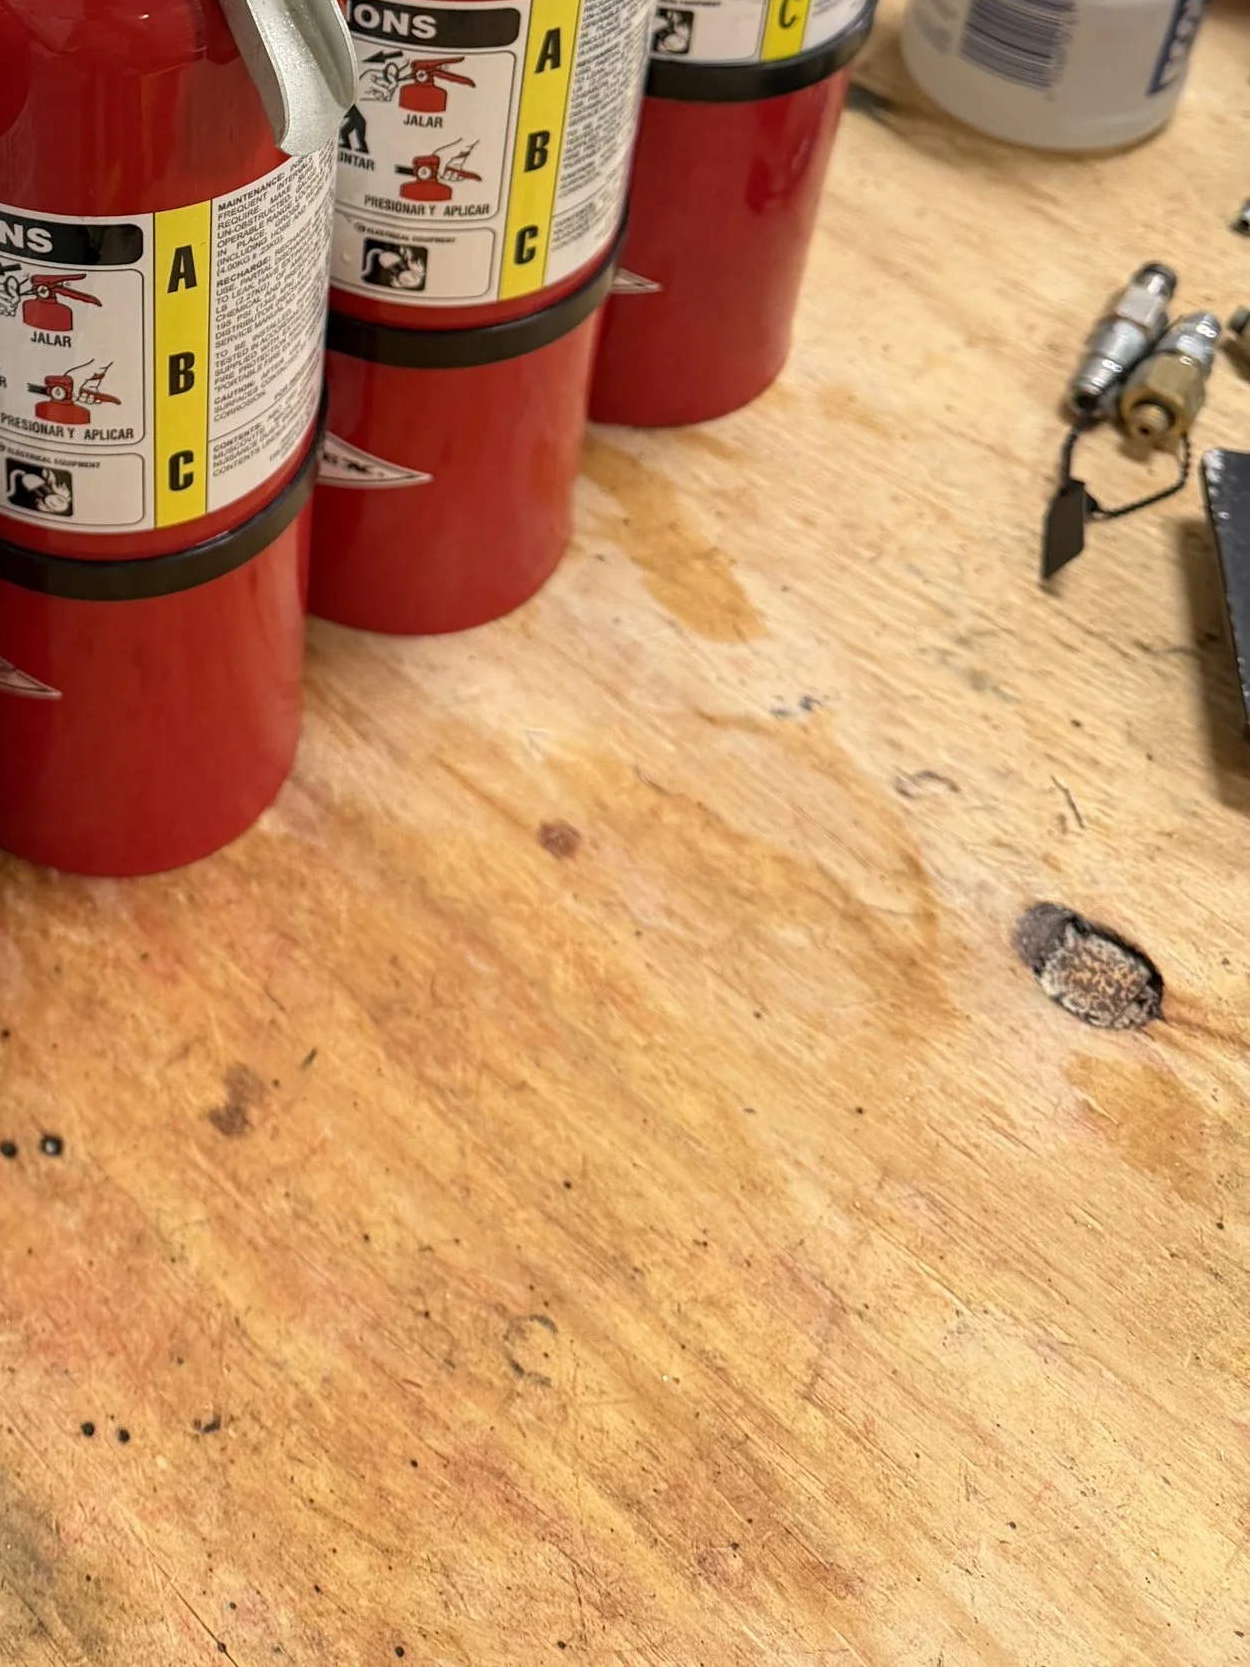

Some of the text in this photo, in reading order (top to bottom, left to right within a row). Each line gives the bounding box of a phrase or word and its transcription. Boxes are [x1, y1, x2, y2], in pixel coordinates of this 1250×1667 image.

[346, 0, 438, 40] IONS
[403, 113, 444, 129] JALAR
[513, 26, 562, 266] A B C
[218, 172, 285, 212] MAINTENANCE:
[218, 191, 268, 221] FREQUENT
[270, 184, 292, 203] MAKE
[364, 195, 490, 217] PRESIONAR Y APLICAR
[217, 219, 265, 248] OPERABLE
[216, 256, 271, 287] RECHARGE:
[30, 331, 72, 348] JALAR
[215, 327, 253, 349] SERVICE
[167, 244, 198, 492] A B C
[0, 412, 134, 441] PRESIONAR Y APLICAR
